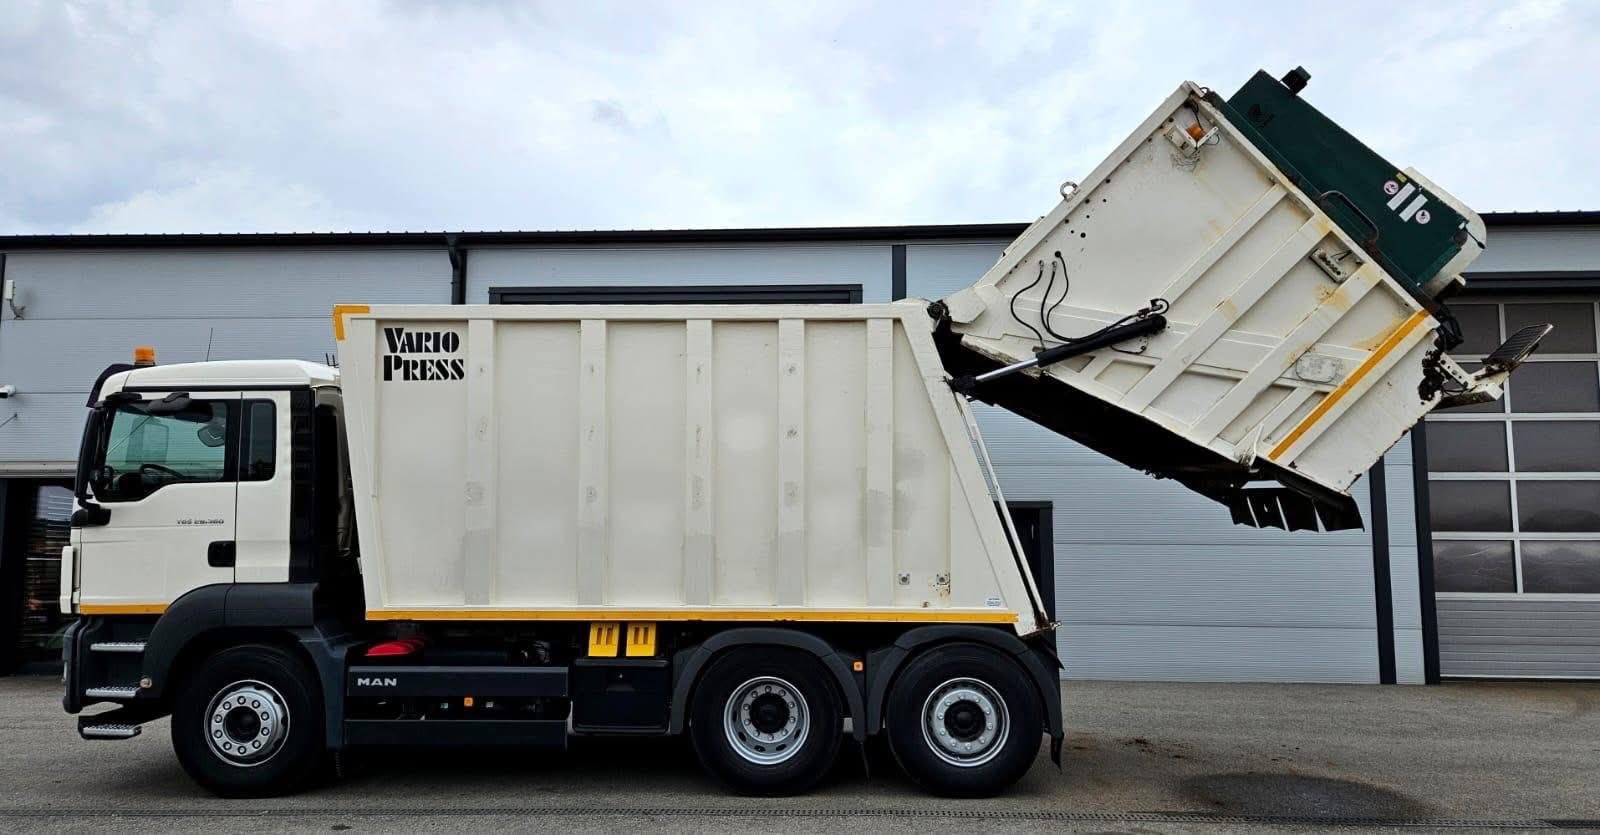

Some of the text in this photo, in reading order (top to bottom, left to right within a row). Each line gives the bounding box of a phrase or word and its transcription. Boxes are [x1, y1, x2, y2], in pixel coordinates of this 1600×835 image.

[384, 328, 459, 353] VARIO
[384, 355, 464, 381] PRESS
[357, 678, 397, 686] MAN
